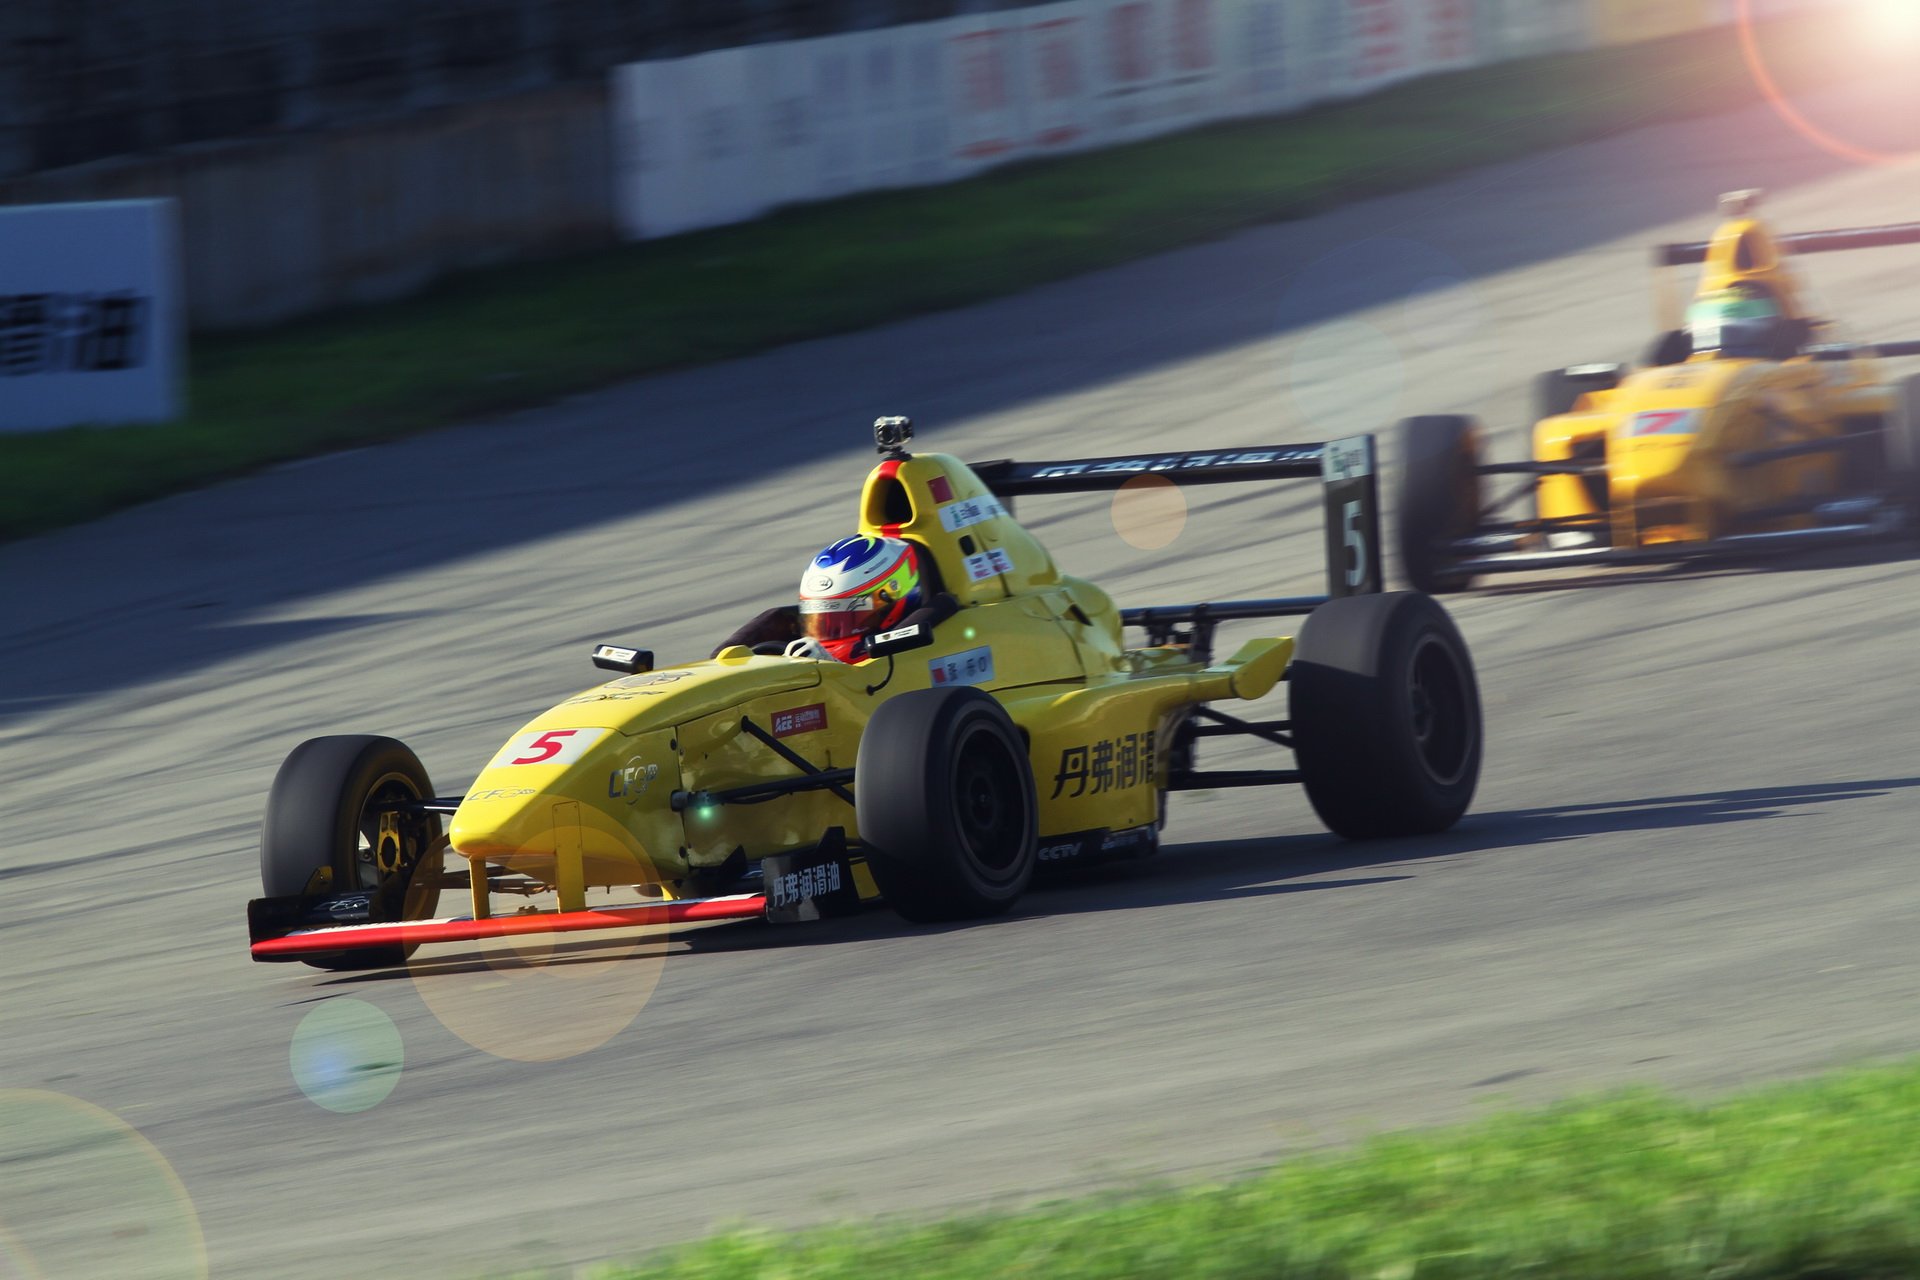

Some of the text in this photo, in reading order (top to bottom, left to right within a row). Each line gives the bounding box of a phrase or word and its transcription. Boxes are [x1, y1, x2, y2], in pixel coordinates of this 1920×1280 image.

[1636, 410, 1692, 436] 7
[1342, 499, 1368, 588] 5
[511, 729, 579, 765] 5
[1038, 841, 1082, 861] CCTV
[773, 860, 841, 908] 丹弗润滑油
